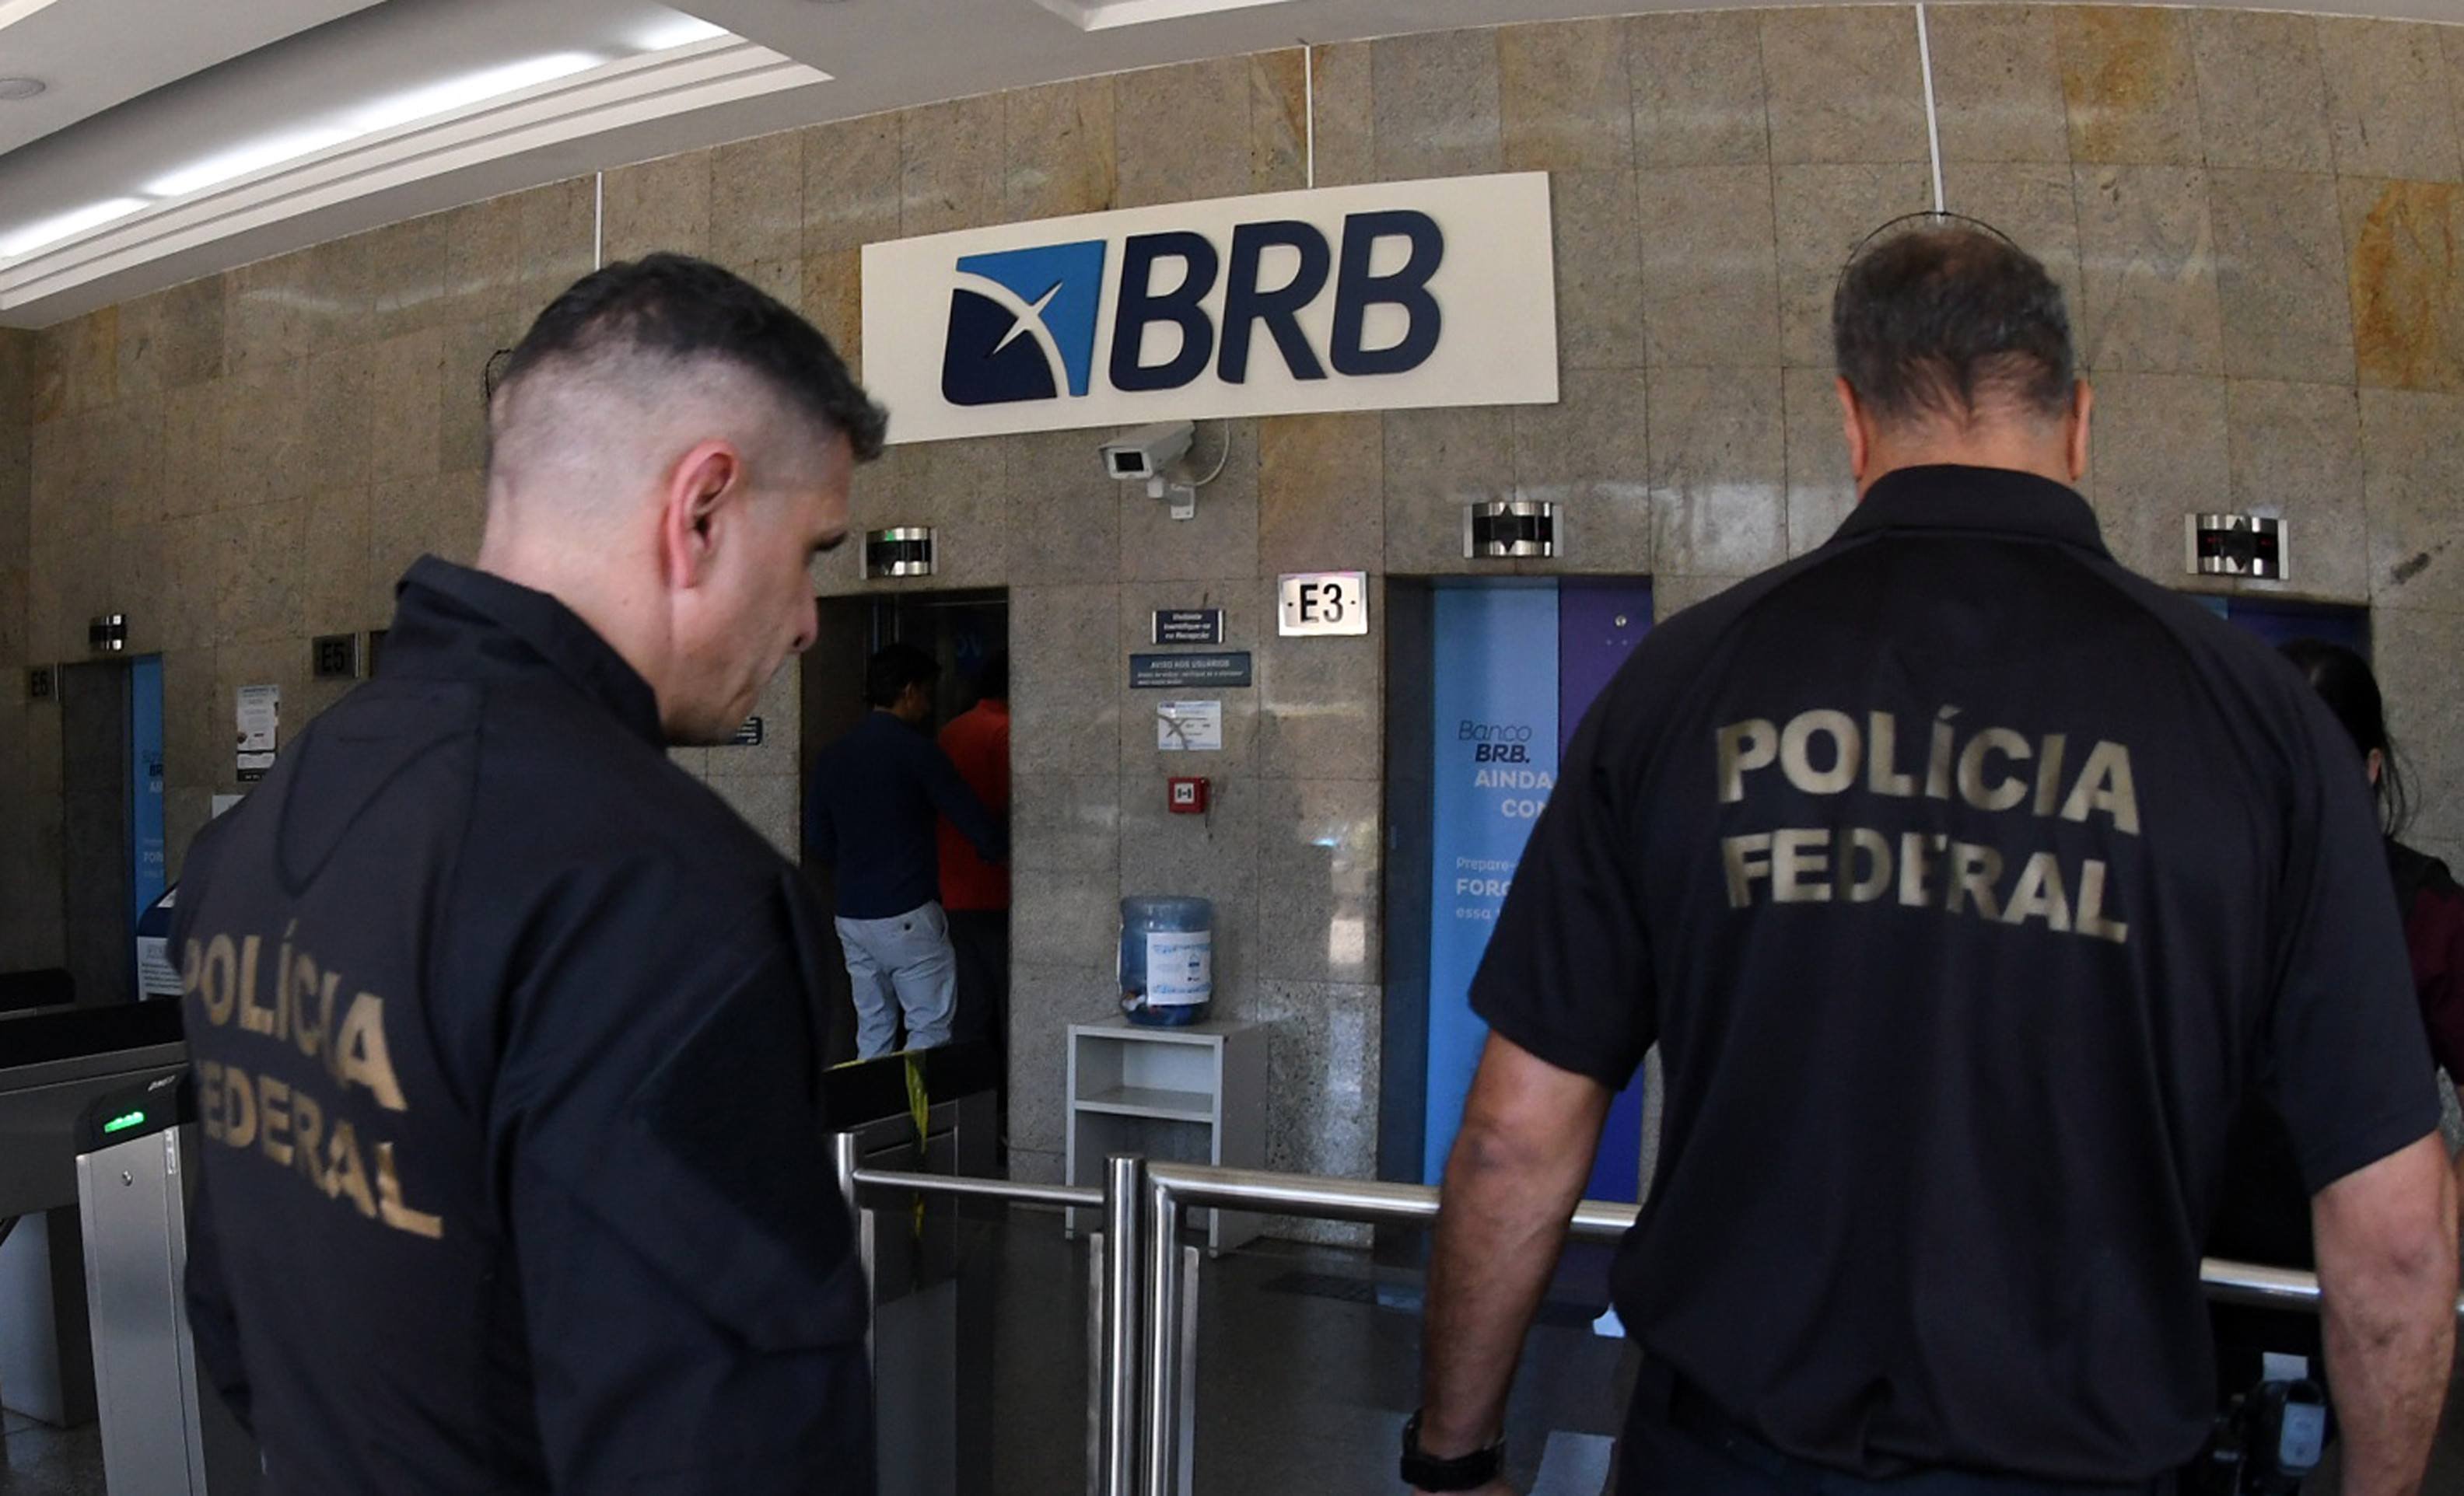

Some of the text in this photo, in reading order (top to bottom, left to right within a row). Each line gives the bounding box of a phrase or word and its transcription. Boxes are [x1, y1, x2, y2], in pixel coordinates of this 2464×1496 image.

[1109, 209, 1444, 393] BRB
[1299, 583, 1344, 624] E3
[323, 642, 345, 672] E5
[1458, 720, 1532, 741] Banco
[1475, 743, 1531, 764] BRB.
[1717, 704, 2140, 836] POLÍCIA
[1475, 770, 1553, 789] AINDA
[1720, 828, 2129, 944] FEDERAL
[1456, 908, 1491, 920] essa
[196, 1058, 443, 1239] EDERAL
